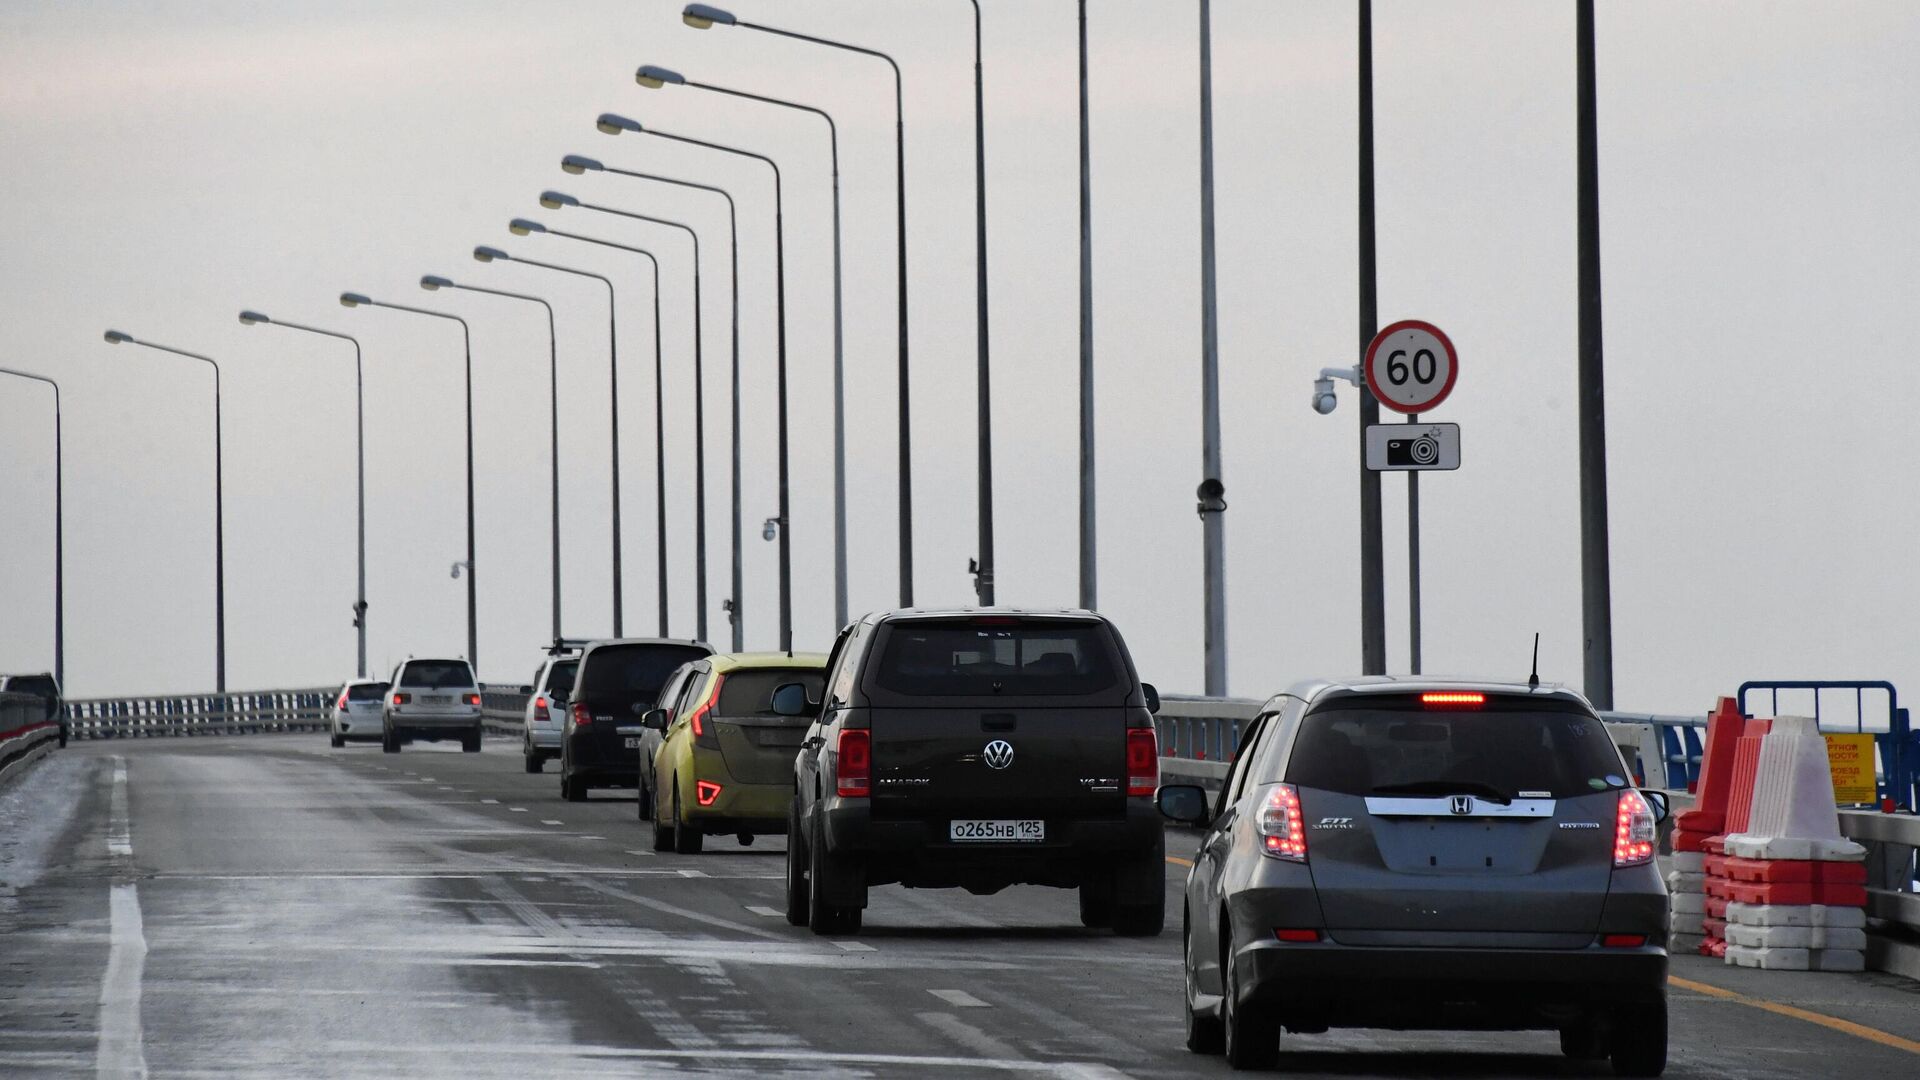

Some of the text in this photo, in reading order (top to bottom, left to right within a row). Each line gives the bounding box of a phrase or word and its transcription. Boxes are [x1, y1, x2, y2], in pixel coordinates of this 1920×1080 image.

[1387, 349, 1436, 385] 60
[955, 821, 1040, 837] О265НВ 125
